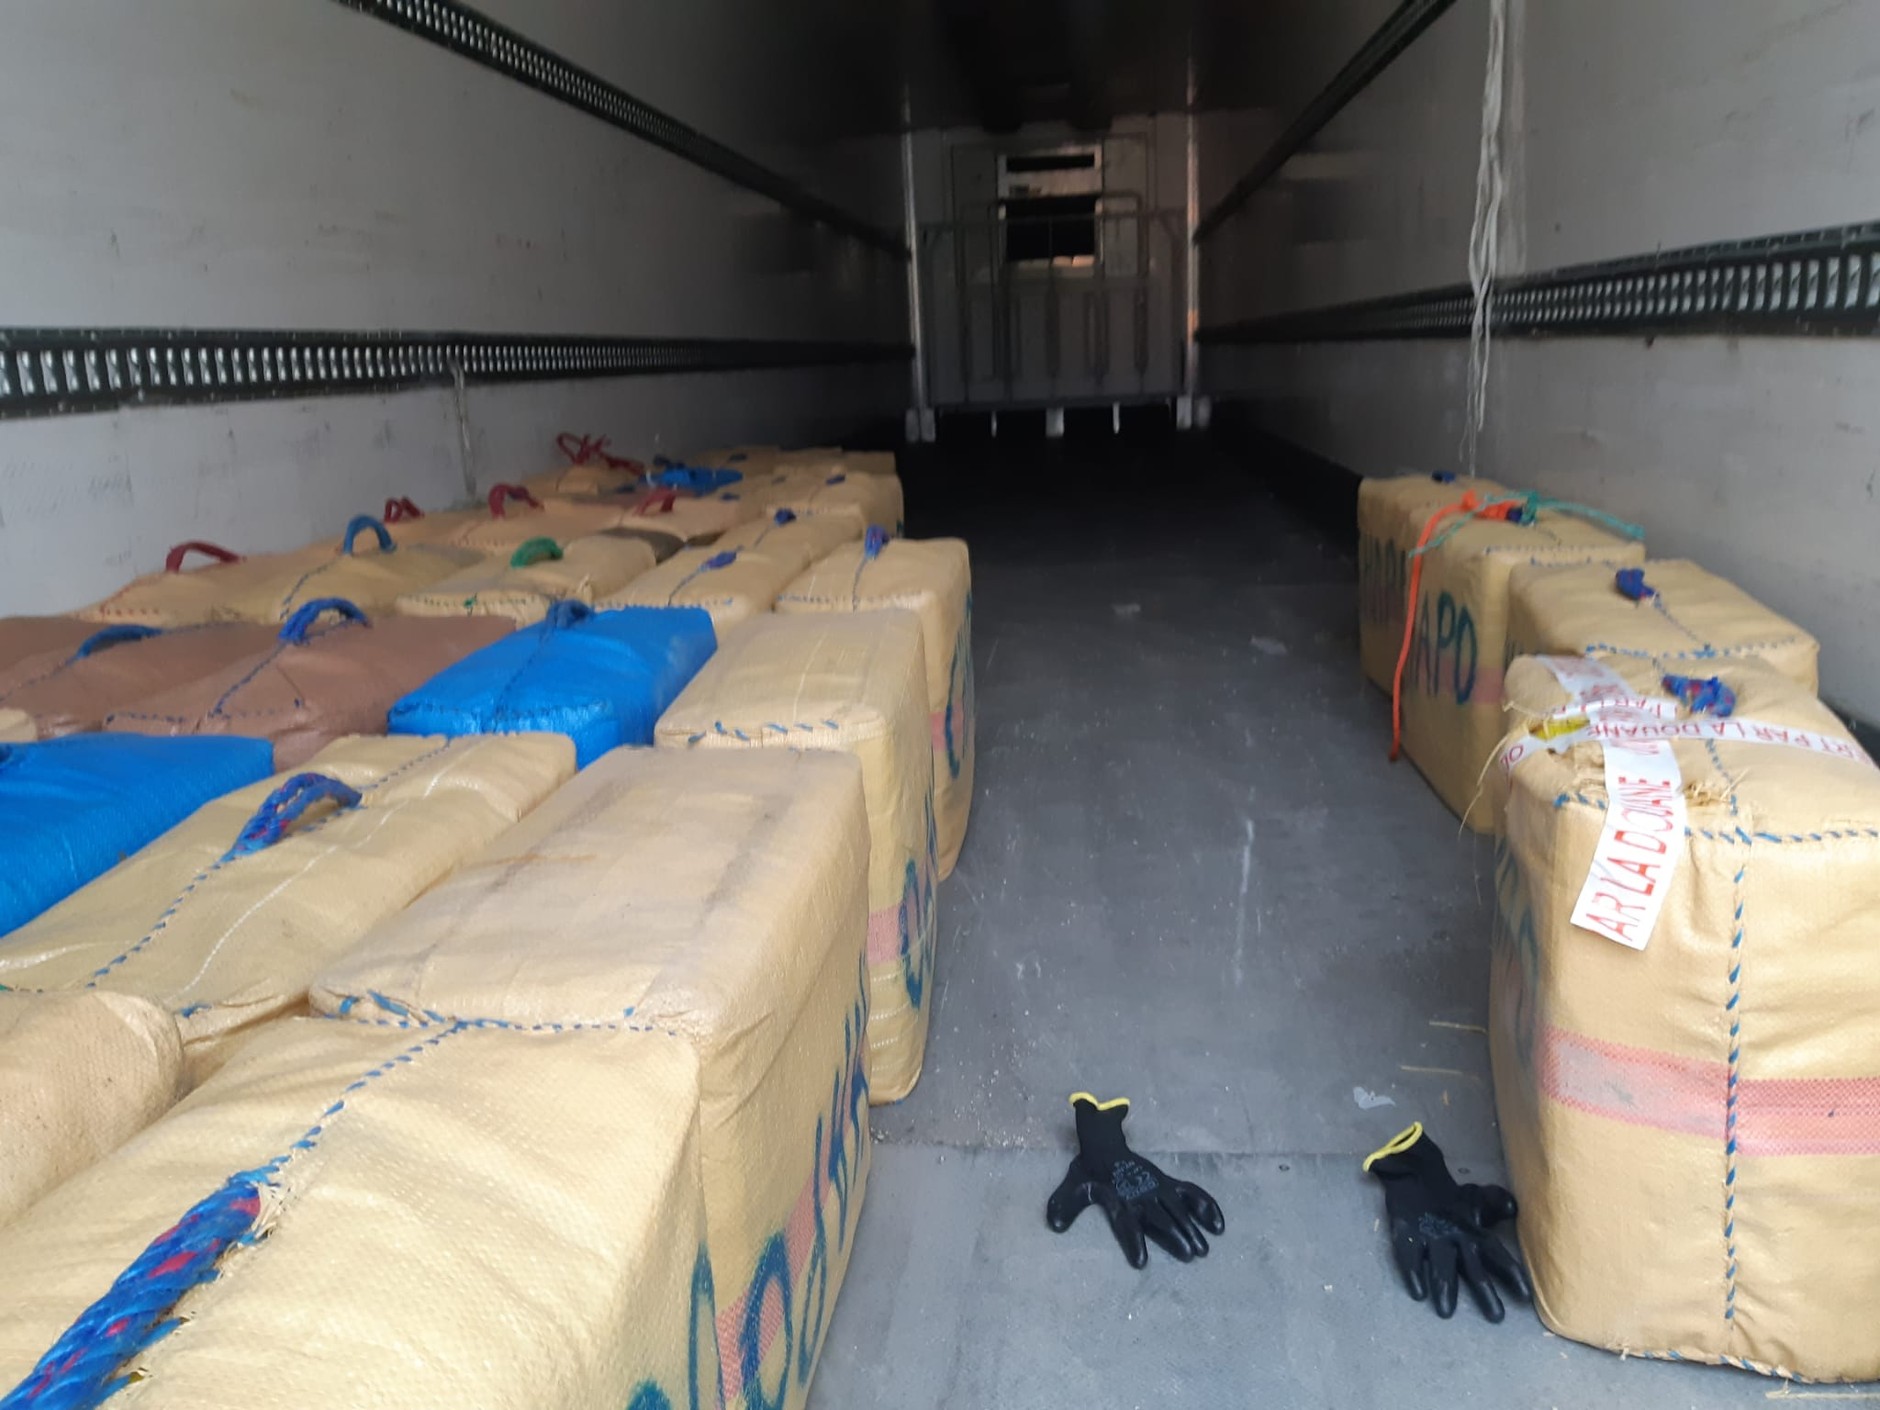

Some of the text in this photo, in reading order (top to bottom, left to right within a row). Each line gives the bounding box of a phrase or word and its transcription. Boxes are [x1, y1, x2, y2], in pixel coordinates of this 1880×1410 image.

[1587, 722, 1700, 738] DOUANE
[1711, 721, 1746, 738] LA
[1600, 857, 1661, 896] LA
